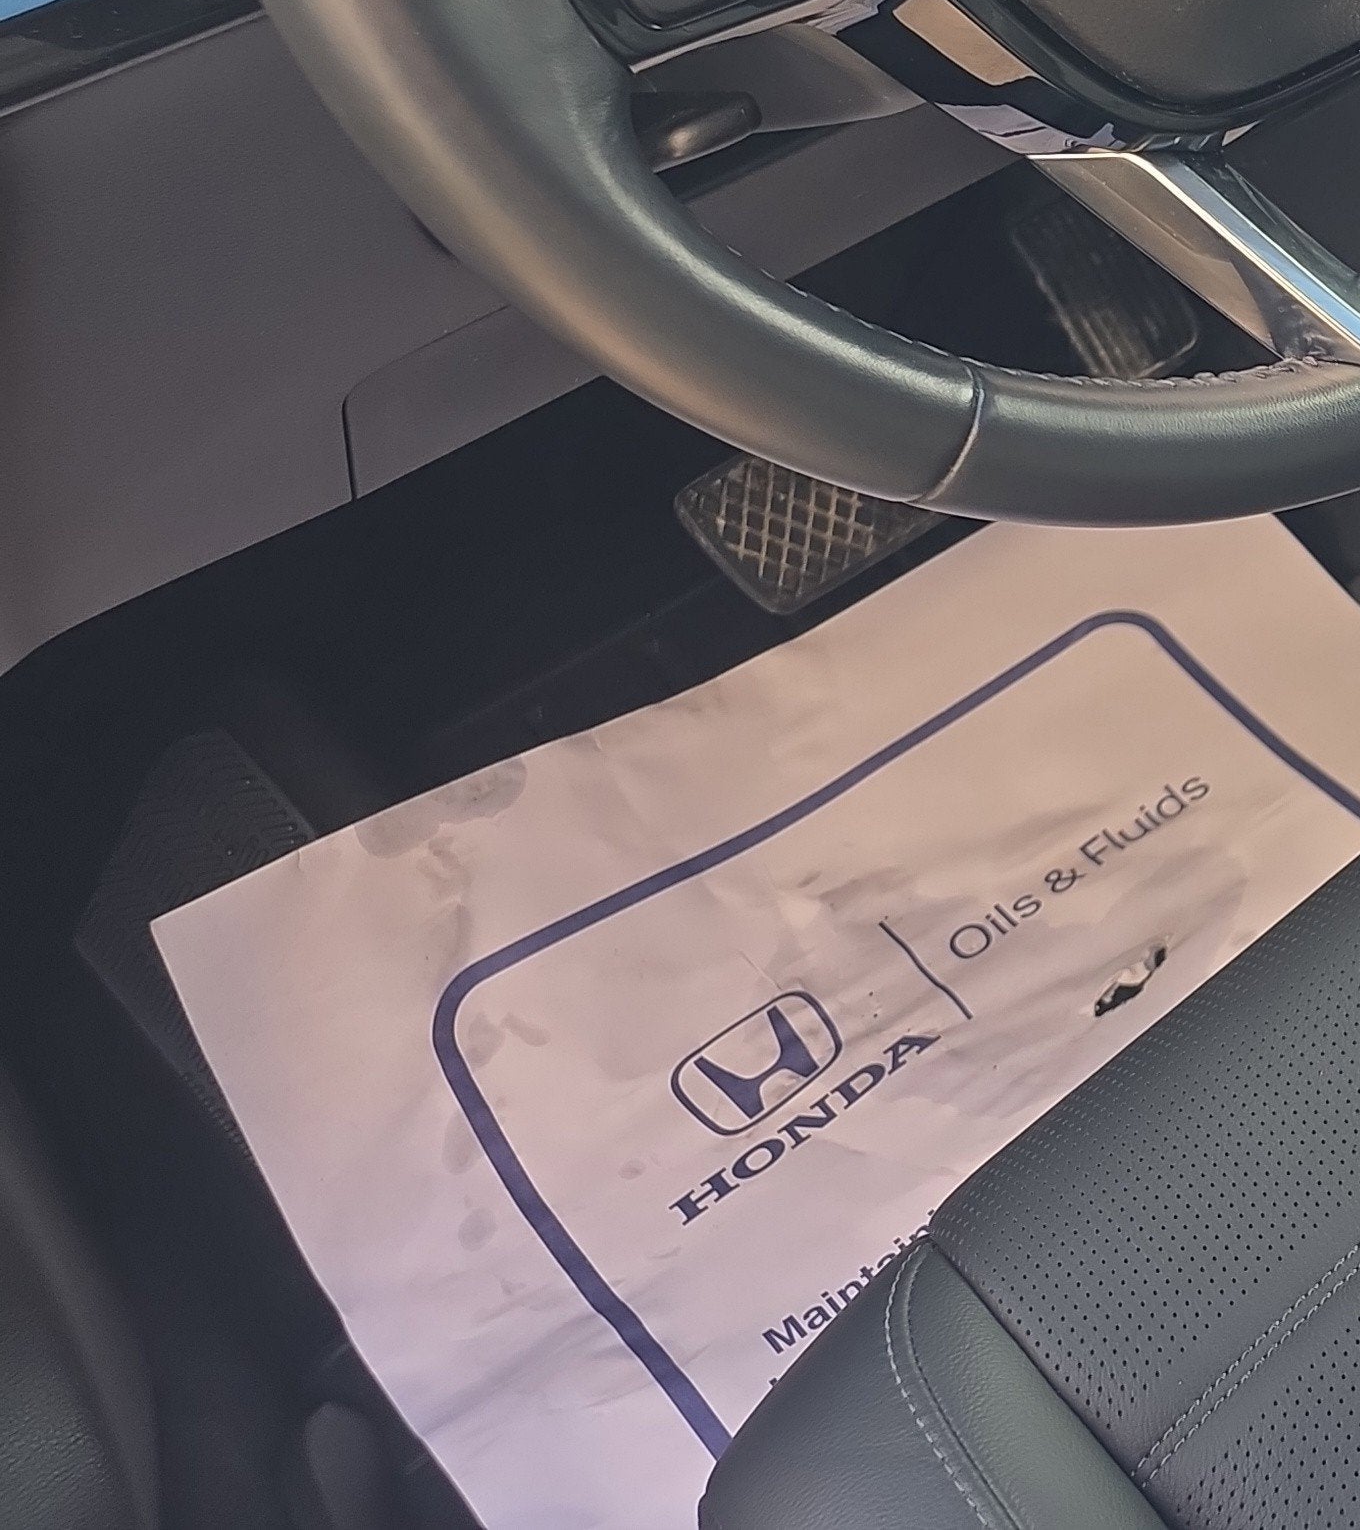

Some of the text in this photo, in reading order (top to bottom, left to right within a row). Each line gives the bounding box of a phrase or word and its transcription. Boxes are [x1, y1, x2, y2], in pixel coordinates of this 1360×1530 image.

[949, 774, 1212, 961] Oils & Fluids
[669, 1031, 942, 1226] HONDA
